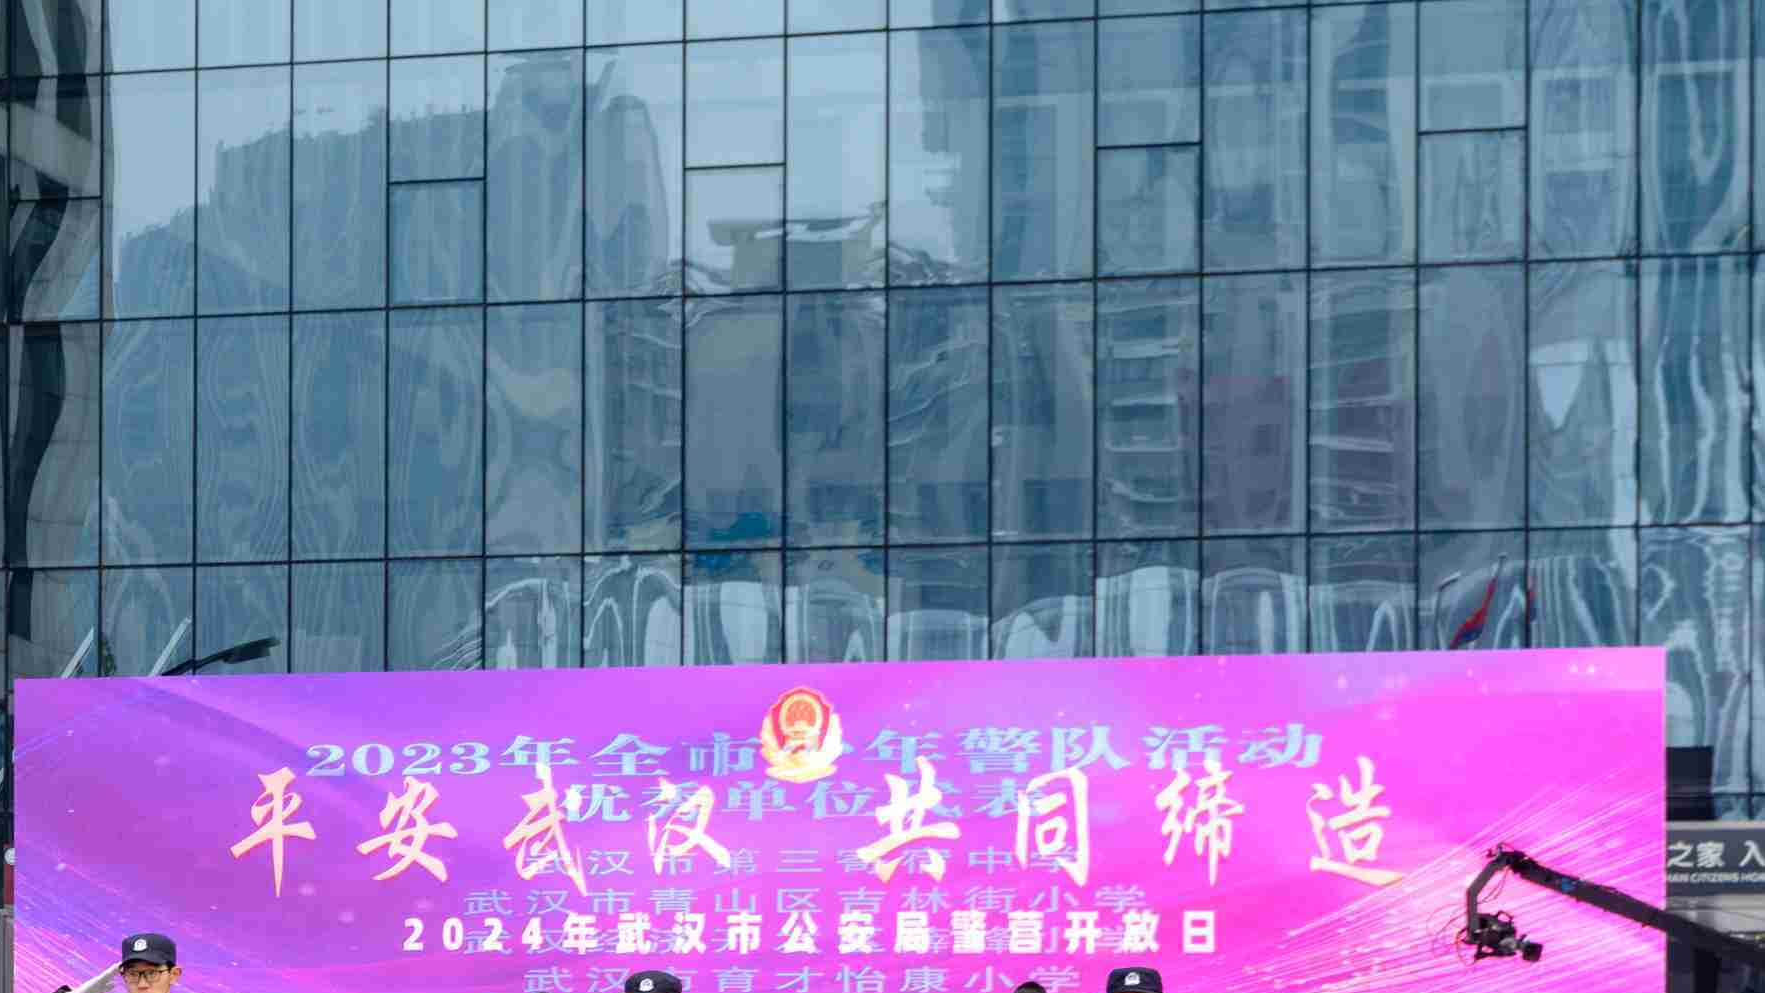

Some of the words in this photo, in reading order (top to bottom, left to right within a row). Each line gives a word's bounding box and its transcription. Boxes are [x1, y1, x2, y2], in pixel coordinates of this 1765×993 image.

[305, 722, 1323, 778] 2023年全市年警队活动
[229, 762, 732, 898] 平安武汉
[856, 754, 1407, 889] 共同缔造
[1667, 840, 1726, 869] 之家
[1739, 839, 1765, 867] 入
[463, 884, 1149, 917] 武汉市青山区吉林街小学
[401, 909, 1216, 955] 2024年武汉市公安局警营开放日
